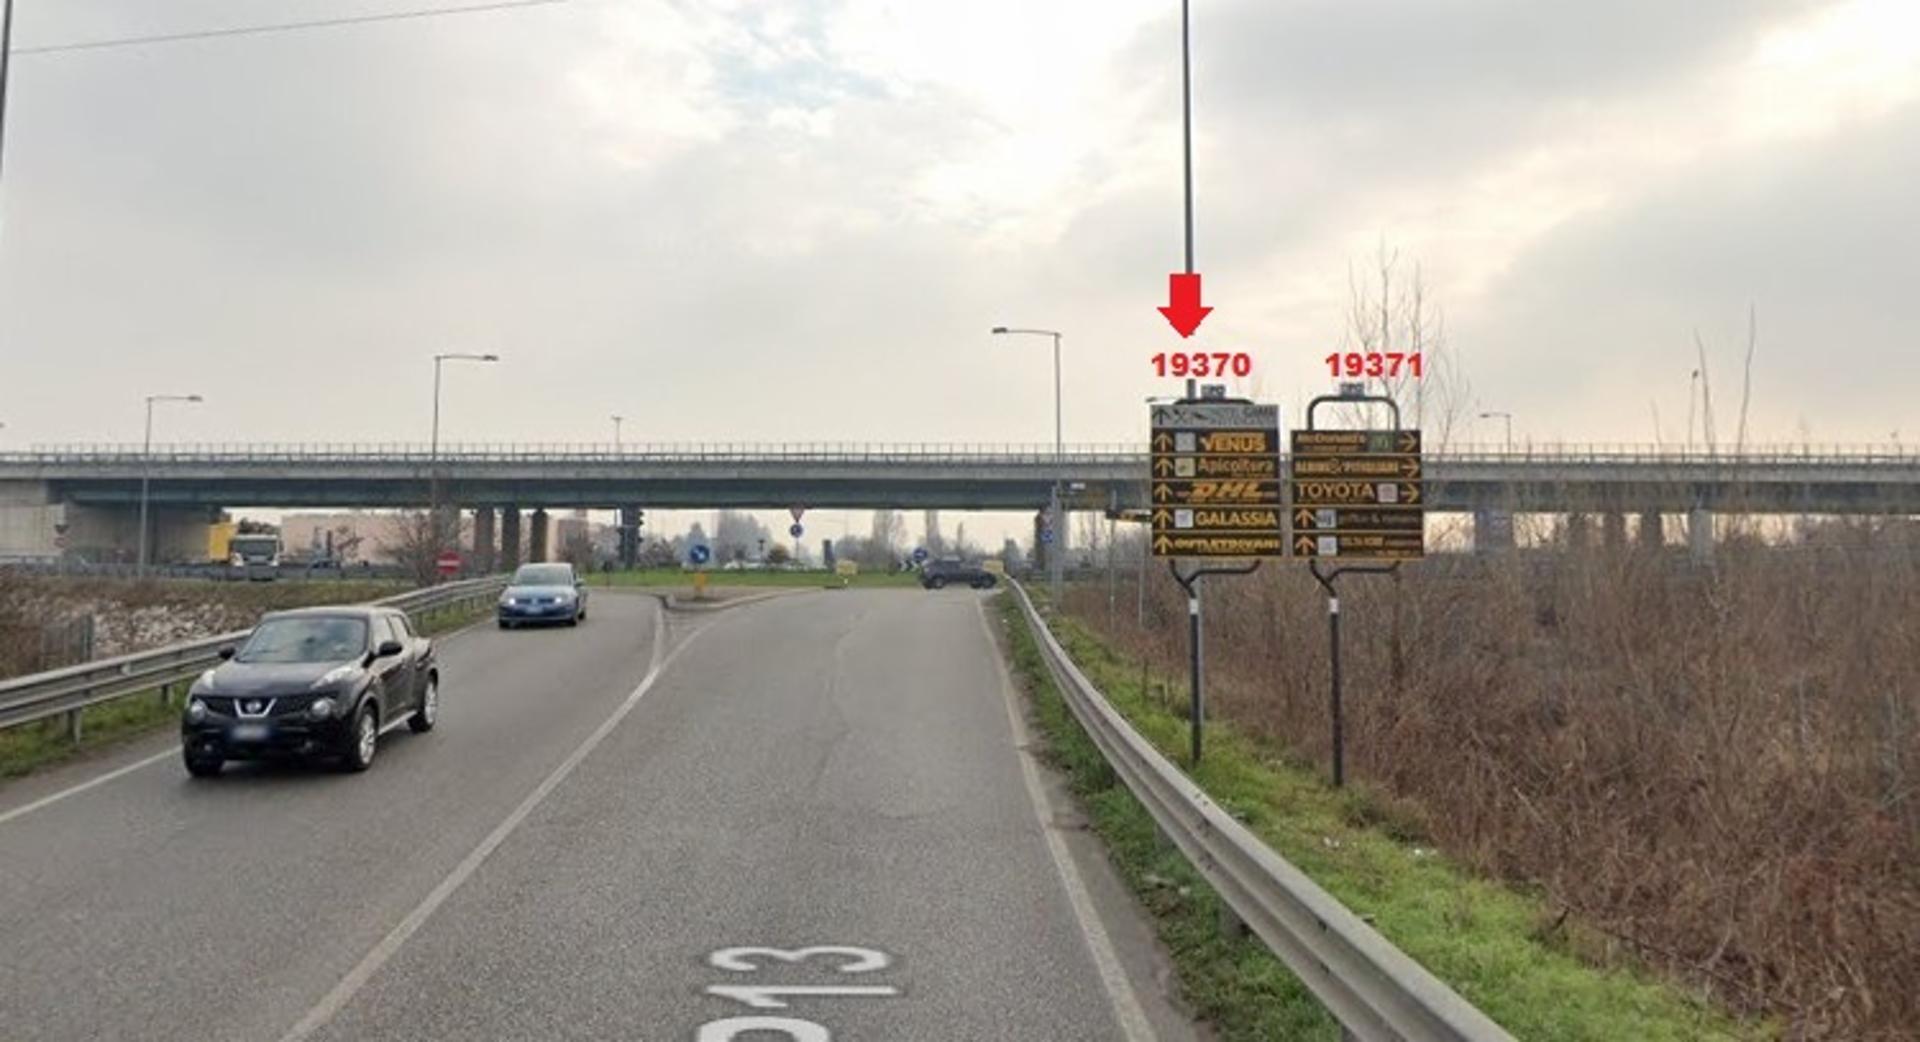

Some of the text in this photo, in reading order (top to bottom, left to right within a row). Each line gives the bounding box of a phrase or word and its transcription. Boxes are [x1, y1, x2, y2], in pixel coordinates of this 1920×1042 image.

[1199, 435, 1267, 452] VENUS
[1197, 457, 1275, 474] Apicoltura
[1190, 481, 1264, 498] DHL
[1297, 482, 1375, 499] TOYOTA
[1195, 510, 1278, 526] GALASSIA
